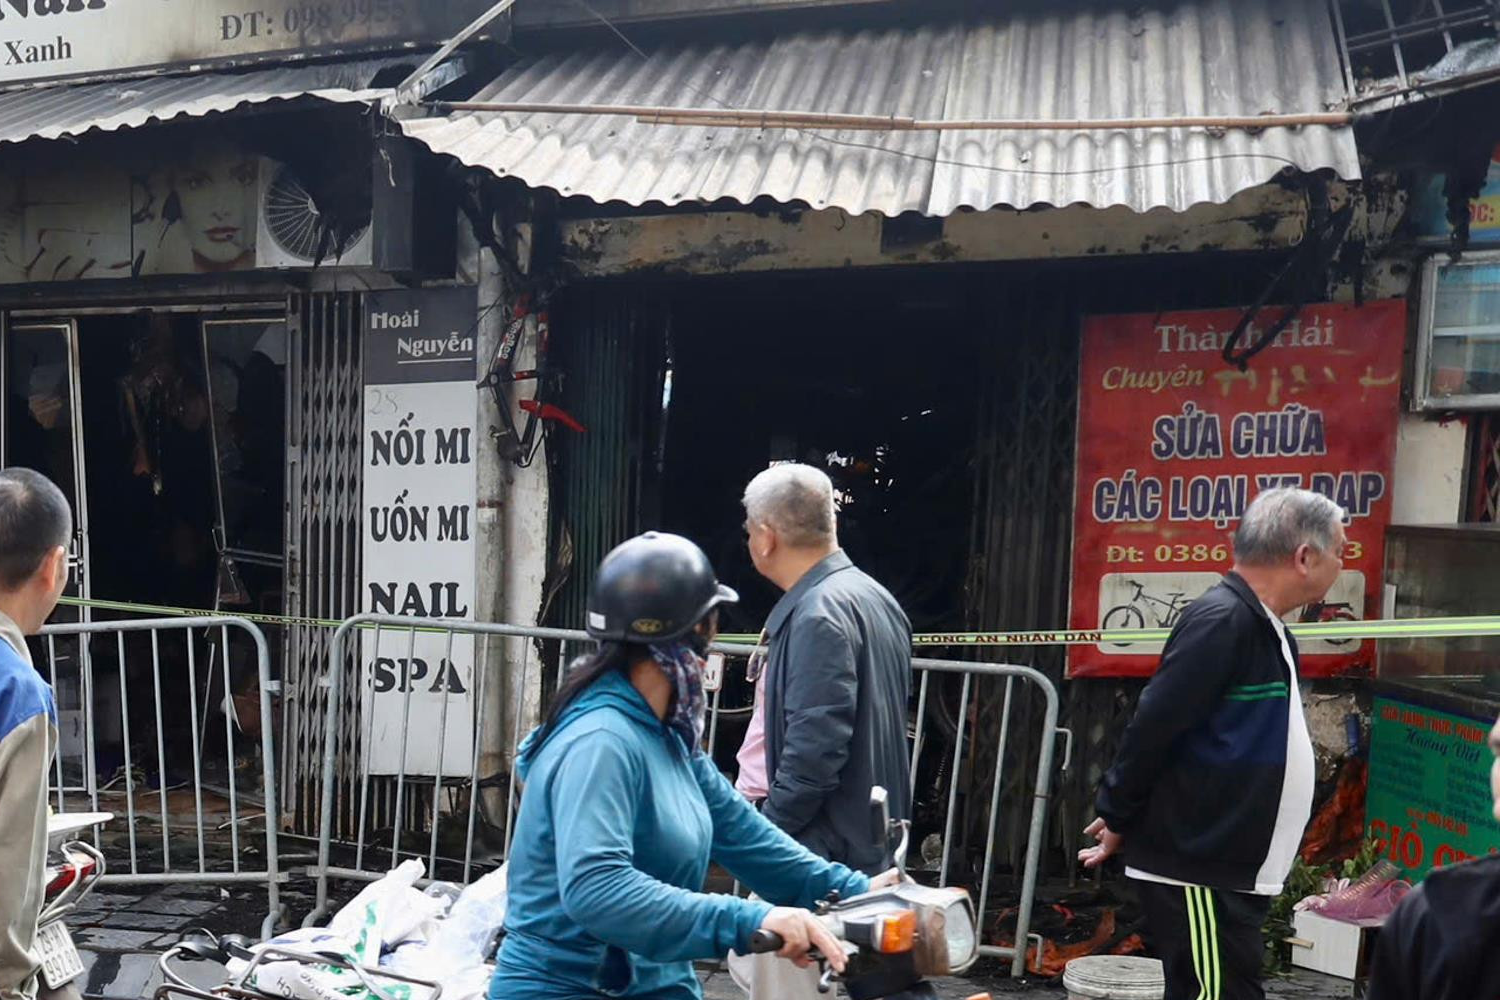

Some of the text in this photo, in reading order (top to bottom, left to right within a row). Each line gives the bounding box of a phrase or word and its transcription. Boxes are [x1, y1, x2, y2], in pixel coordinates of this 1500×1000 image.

[4, 36, 72, 65] Xanh
[397, 331, 473, 357] Nguyễn
[1103, 365, 1205, 392] Chuyên
[370, 411, 471, 466] NỐI MI
[1151, 401, 1327, 460] SỬA CHỮA
[370, 489, 469, 543] UỐN MI
[1092, 469, 1162, 522] CÁC
[1168, 473, 1248, 528] LOẠI
[1106, 545, 1145, 563] Đt:
[1155, 544, 1228, 563] 0386
[369, 582, 468, 618] NAIL
[975, 634, 998, 643] AN
[368, 656, 467, 694] SPA
